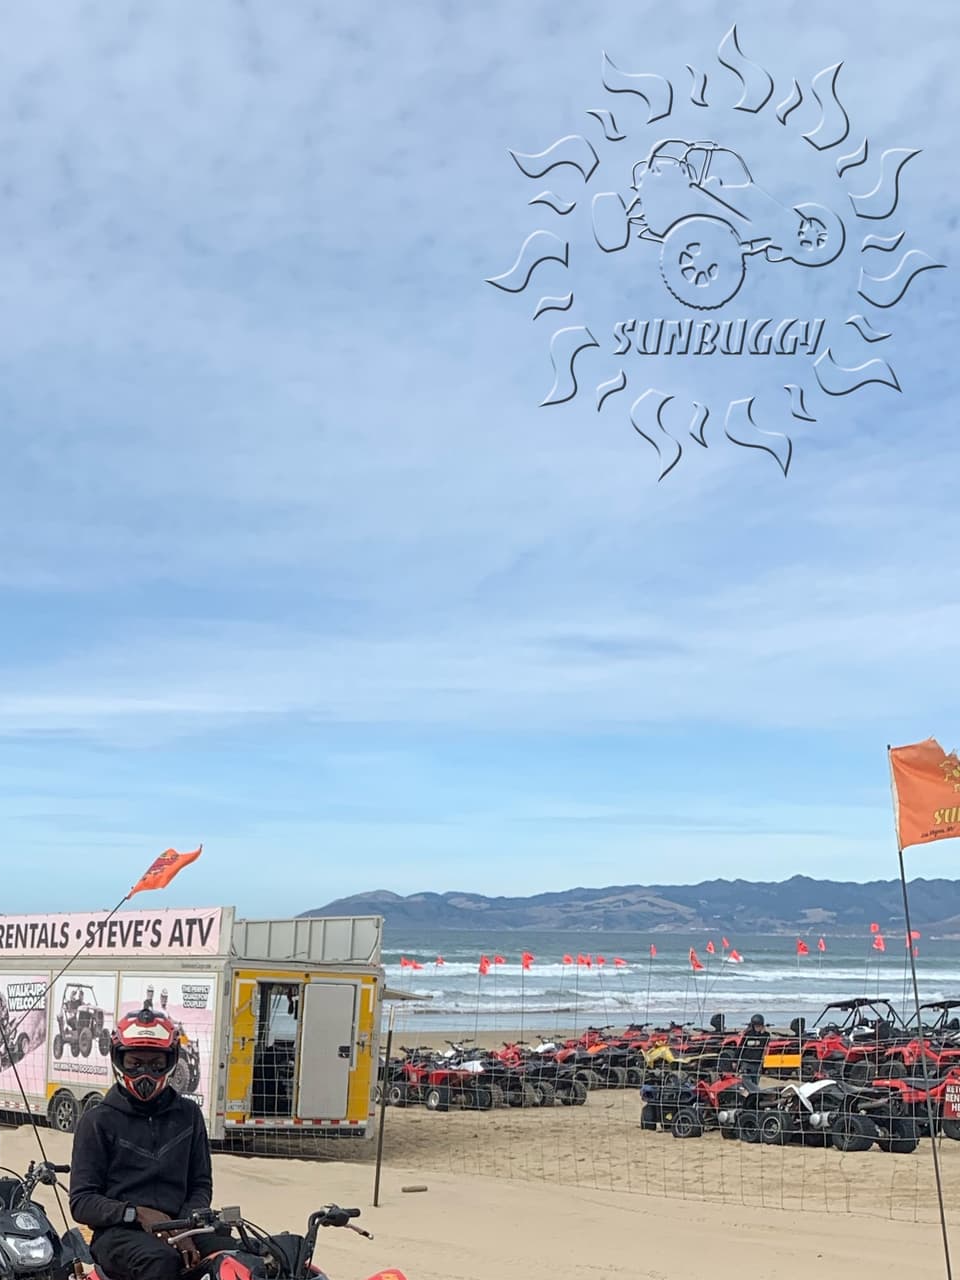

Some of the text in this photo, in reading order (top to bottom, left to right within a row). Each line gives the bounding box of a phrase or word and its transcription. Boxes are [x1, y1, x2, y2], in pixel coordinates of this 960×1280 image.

[86, 919, 162, 949] STEVE'S
[168, 917, 214, 947] ATV
[8, 996, 46, 1011] WELCOME
